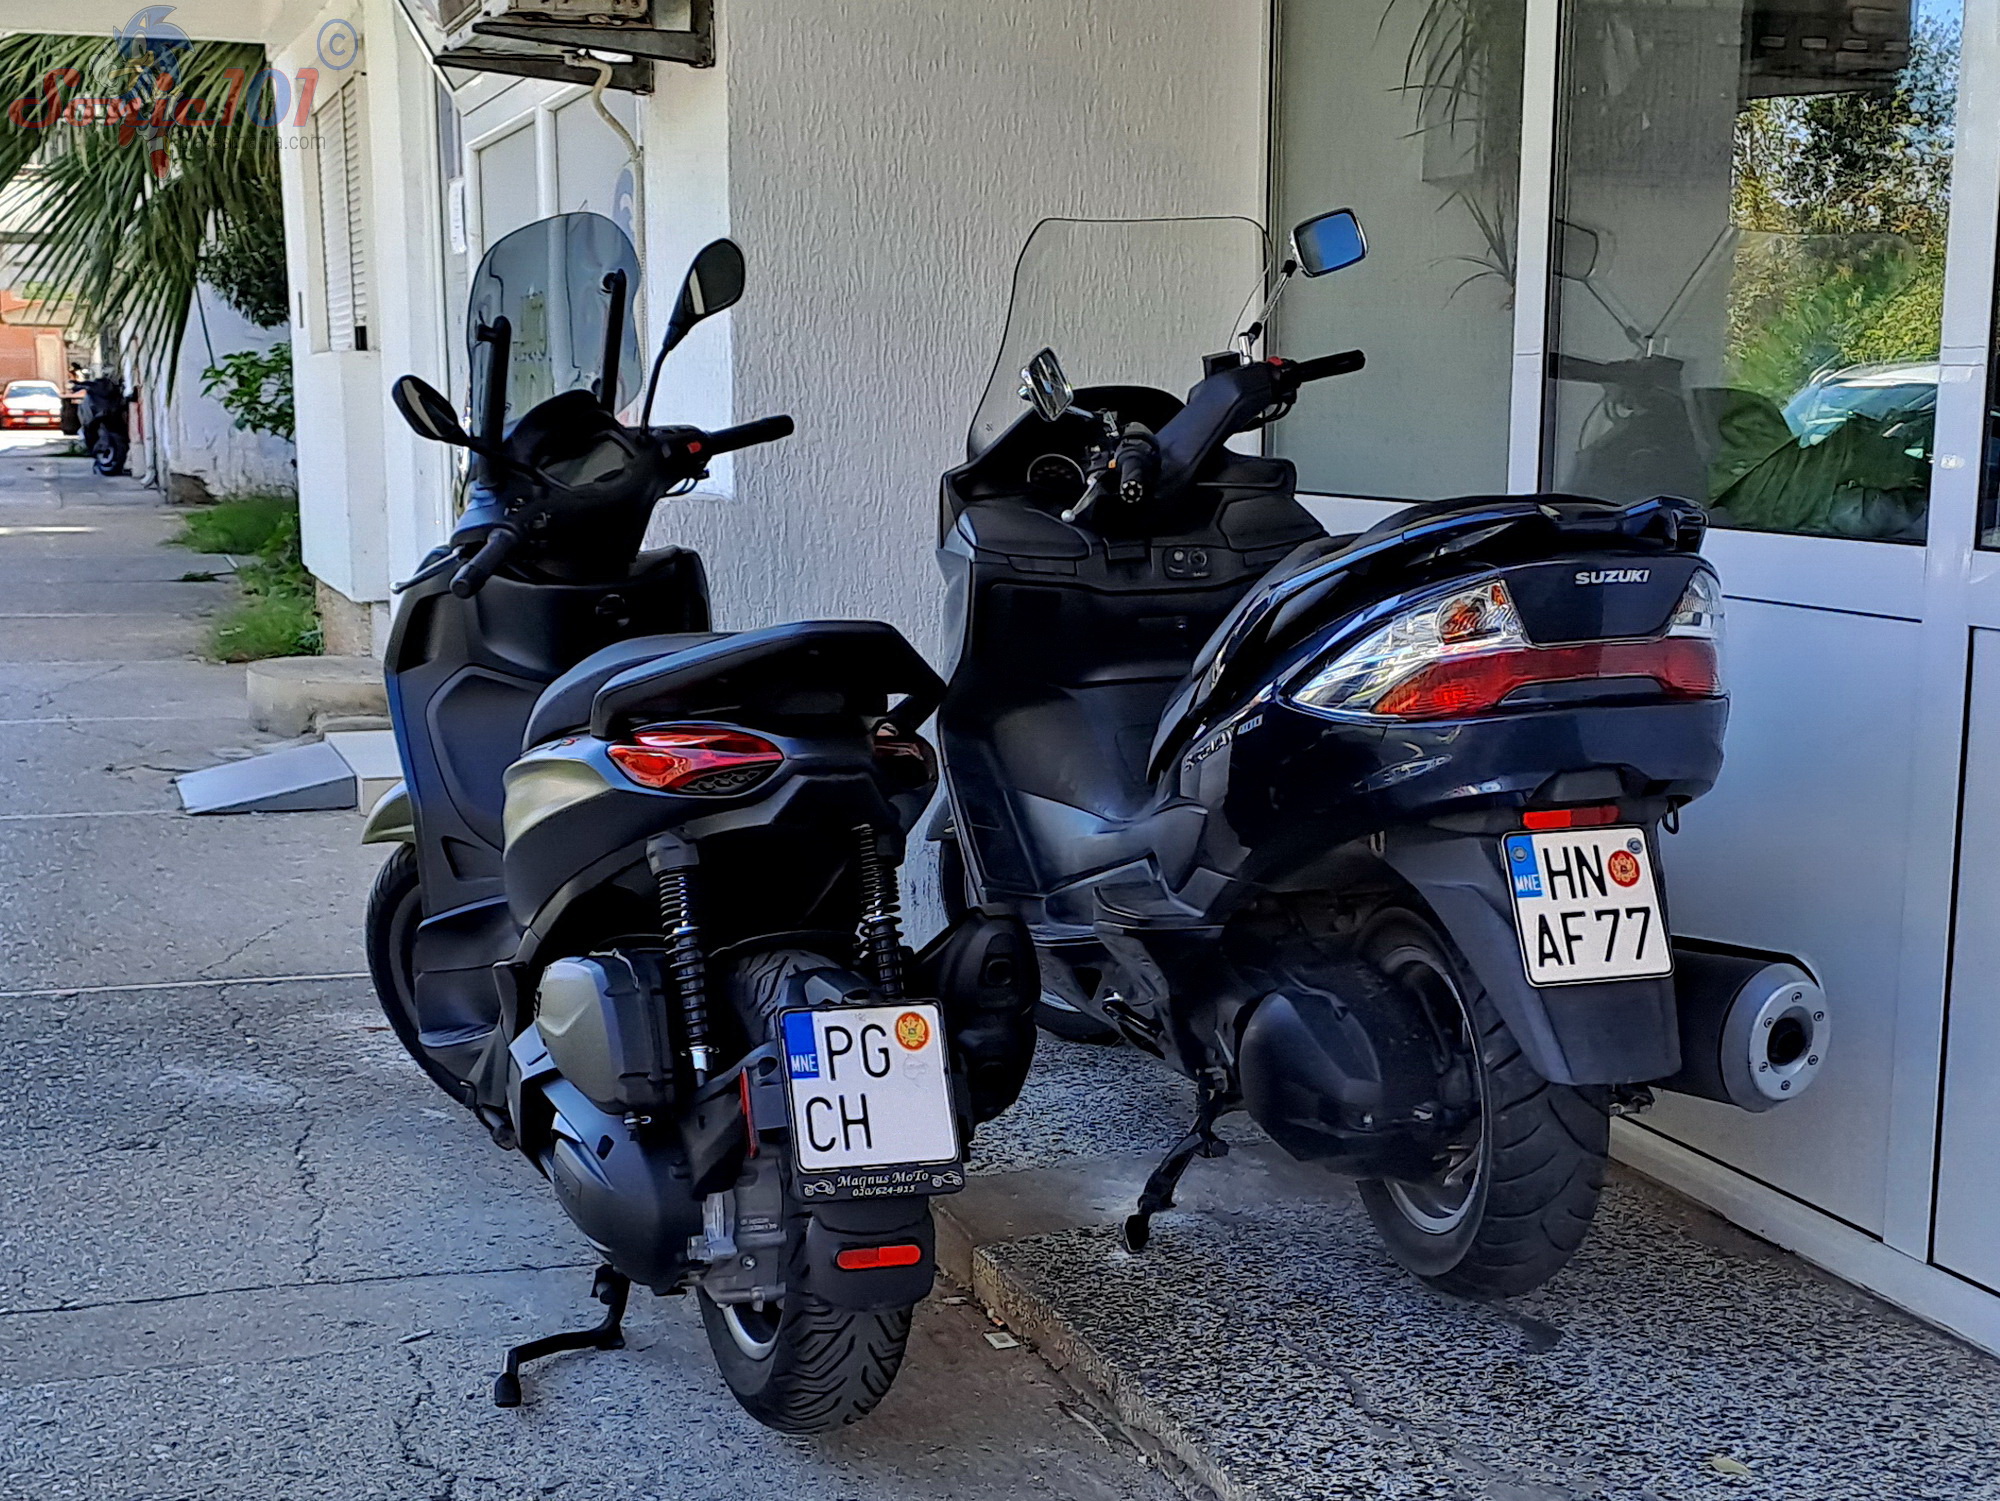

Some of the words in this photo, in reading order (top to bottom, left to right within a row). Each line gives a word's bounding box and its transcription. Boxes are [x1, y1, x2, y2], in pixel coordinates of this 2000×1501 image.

[1575, 569, 1650, 585] SUZUKI
[1514, 873, 1542, 893] MNE
[1543, 844, 1608, 900] HN
[1538, 906, 1651, 967] AF77
[790, 1053, 818, 1073] MNE
[824, 1023, 891, 1081] PG
[805, 1093, 873, 1152] CH
[836, 1174, 889, 1190] Magnus
